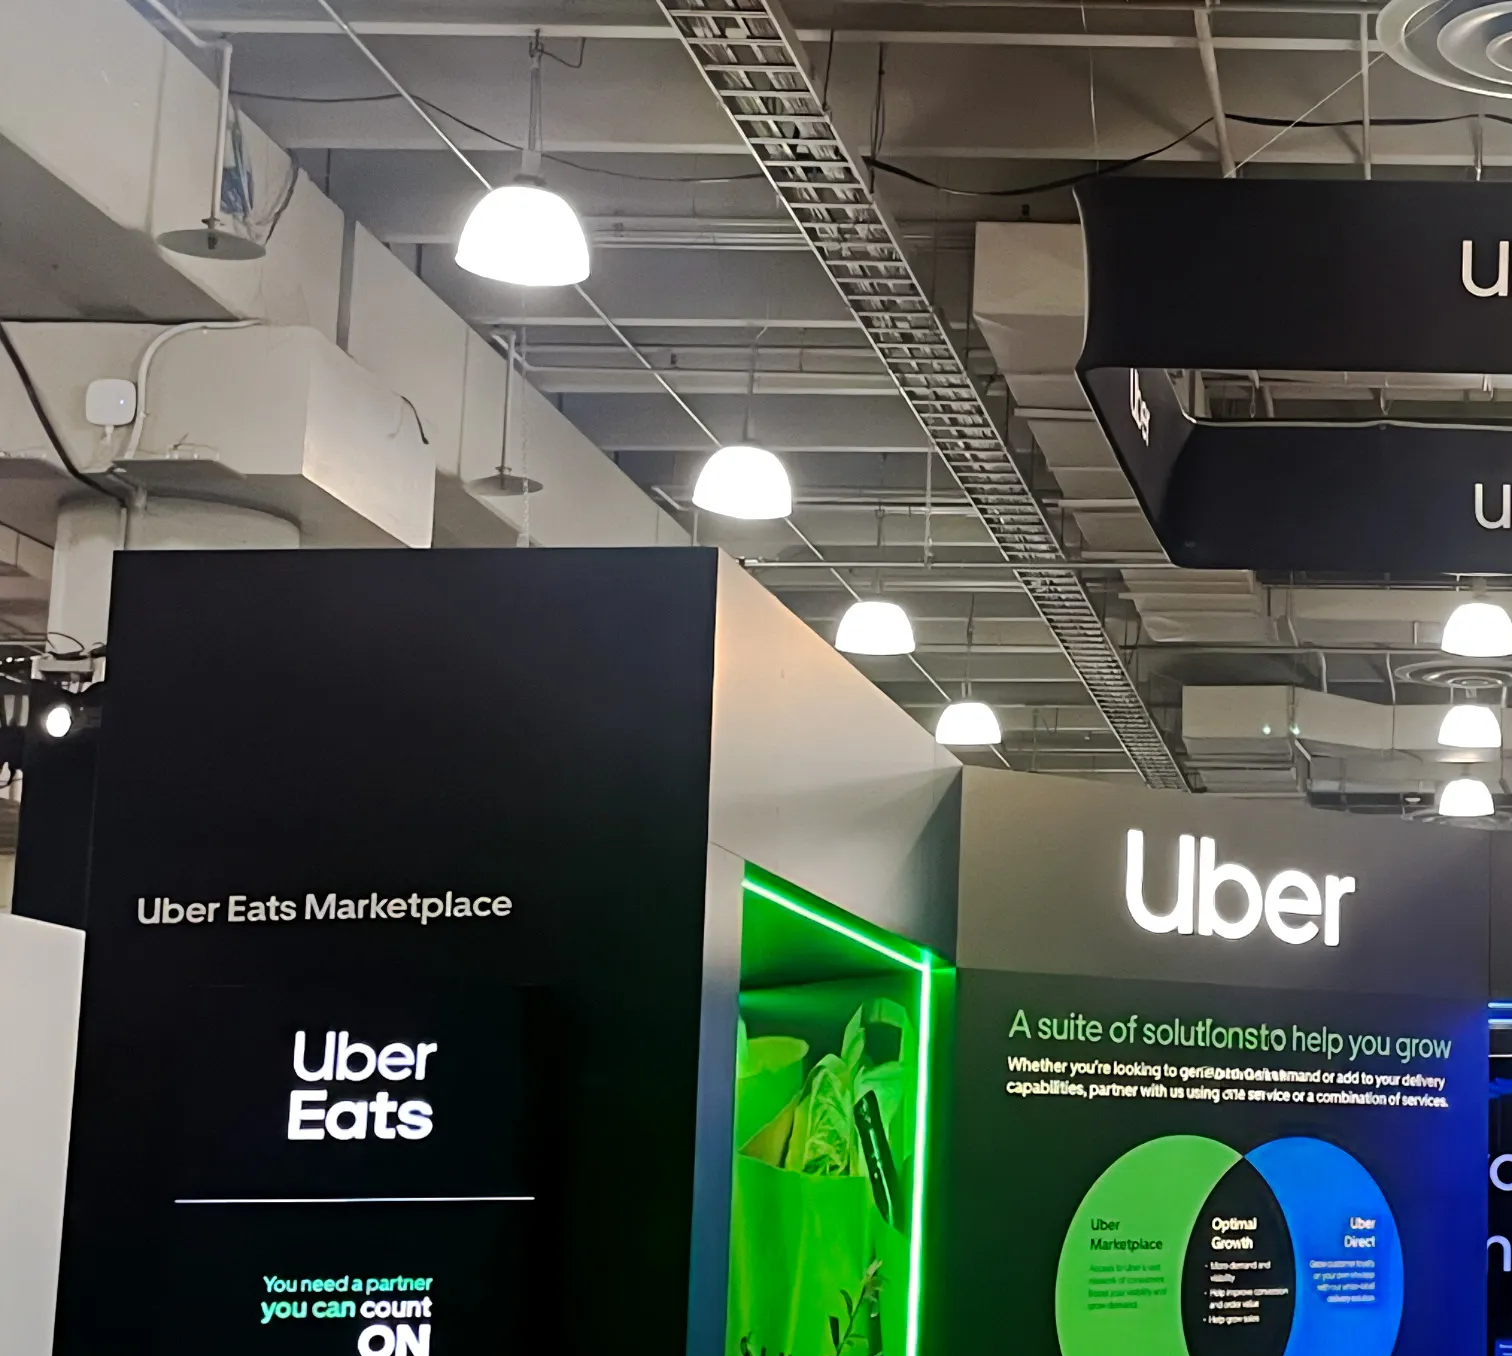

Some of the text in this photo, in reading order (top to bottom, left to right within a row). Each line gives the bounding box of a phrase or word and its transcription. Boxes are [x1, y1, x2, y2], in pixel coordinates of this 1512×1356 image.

[1125, 828, 1356, 947] Uber
[137, 891, 513, 925] Uber Eats Marketplace
[1008, 1008, 1031, 1039] A
[1037, 1012, 1103, 1042] suite
[1109, 1014, 1138, 1044] of
[1291, 1024, 1344, 1060] help
[1348, 1034, 1391, 1062] you
[1395, 1035, 1452, 1064] grow
[292, 1030, 438, 1082] Uber
[1007, 1056, 1068, 1074] Whether
[1070, 1059, 1111, 1077] you're
[1113, 1060, 1162, 1081] looking
[1163, 1063, 1178, 1077] to
[1322, 1070, 1335, 1083] or
[1336, 1070, 1360, 1084] add
[1361, 1071, 1374, 1085] to
[1375, 1075, 1401, 1089] your
[1006, 1079, 1088, 1098] capabilities,
[1089, 1082, 1138, 1100] partner
[1139, 1082, 1168, 1099] with
[1169, 1086, 1186, 1099] us
[1186, 1086, 1220, 1104] using
[1291, 1091, 1306, 1103] or
[1306, 1092, 1315, 1103] a
[1315, 1090, 1387, 1106] combination
[1388, 1091, 1401, 1106] of
[287, 1089, 434, 1141] Eats
[1090, 1218, 1121, 1231] Uber
[1211, 1217, 1258, 1233] Optimal
[1349, 1216, 1377, 1230] Uber
[1090, 1238, 1163, 1252] Marketplace
[1211, 1236, 1254, 1250] Growth
[1343, 1235, 1376, 1248] Direct
[263, 1274, 434, 1296] You need a partner
[260, 1296, 433, 1325] you can count
